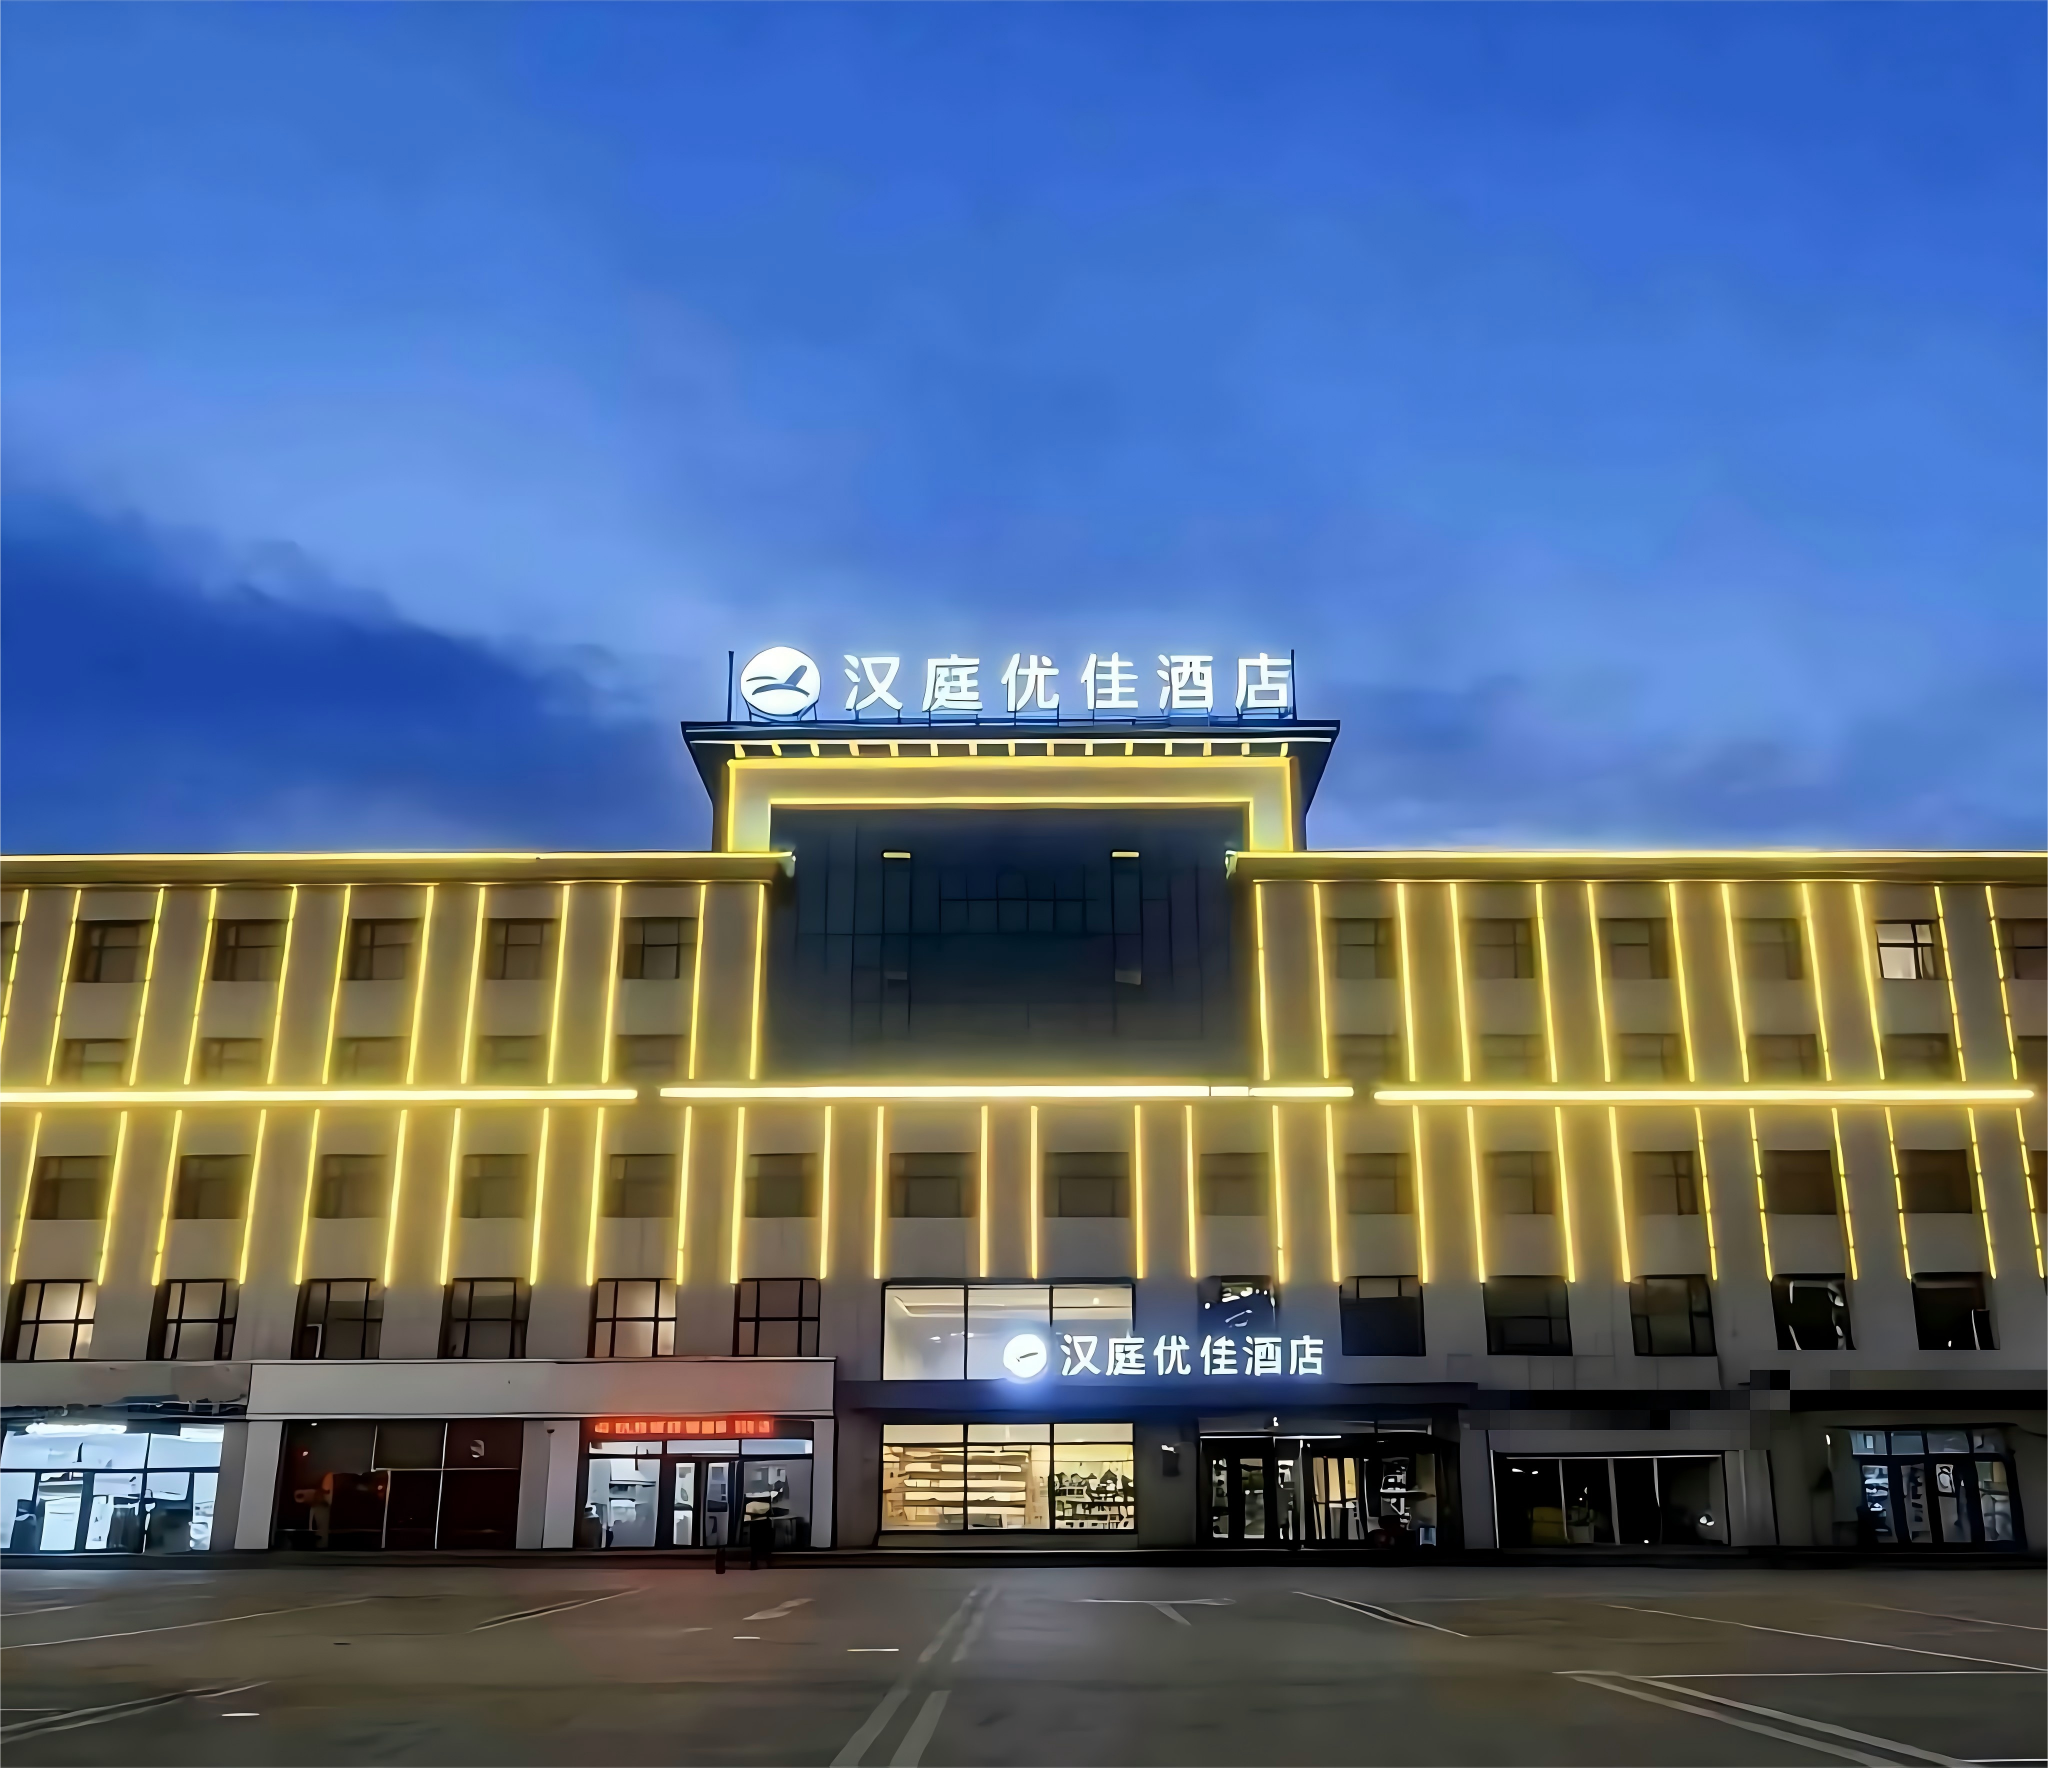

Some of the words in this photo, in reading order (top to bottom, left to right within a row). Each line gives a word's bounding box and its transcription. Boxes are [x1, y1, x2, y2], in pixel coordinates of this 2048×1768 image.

[844, 652, 1292, 711] 汉庭优佳酒店
[1060, 1334, 1325, 1376] 汉庭优佳酒店
